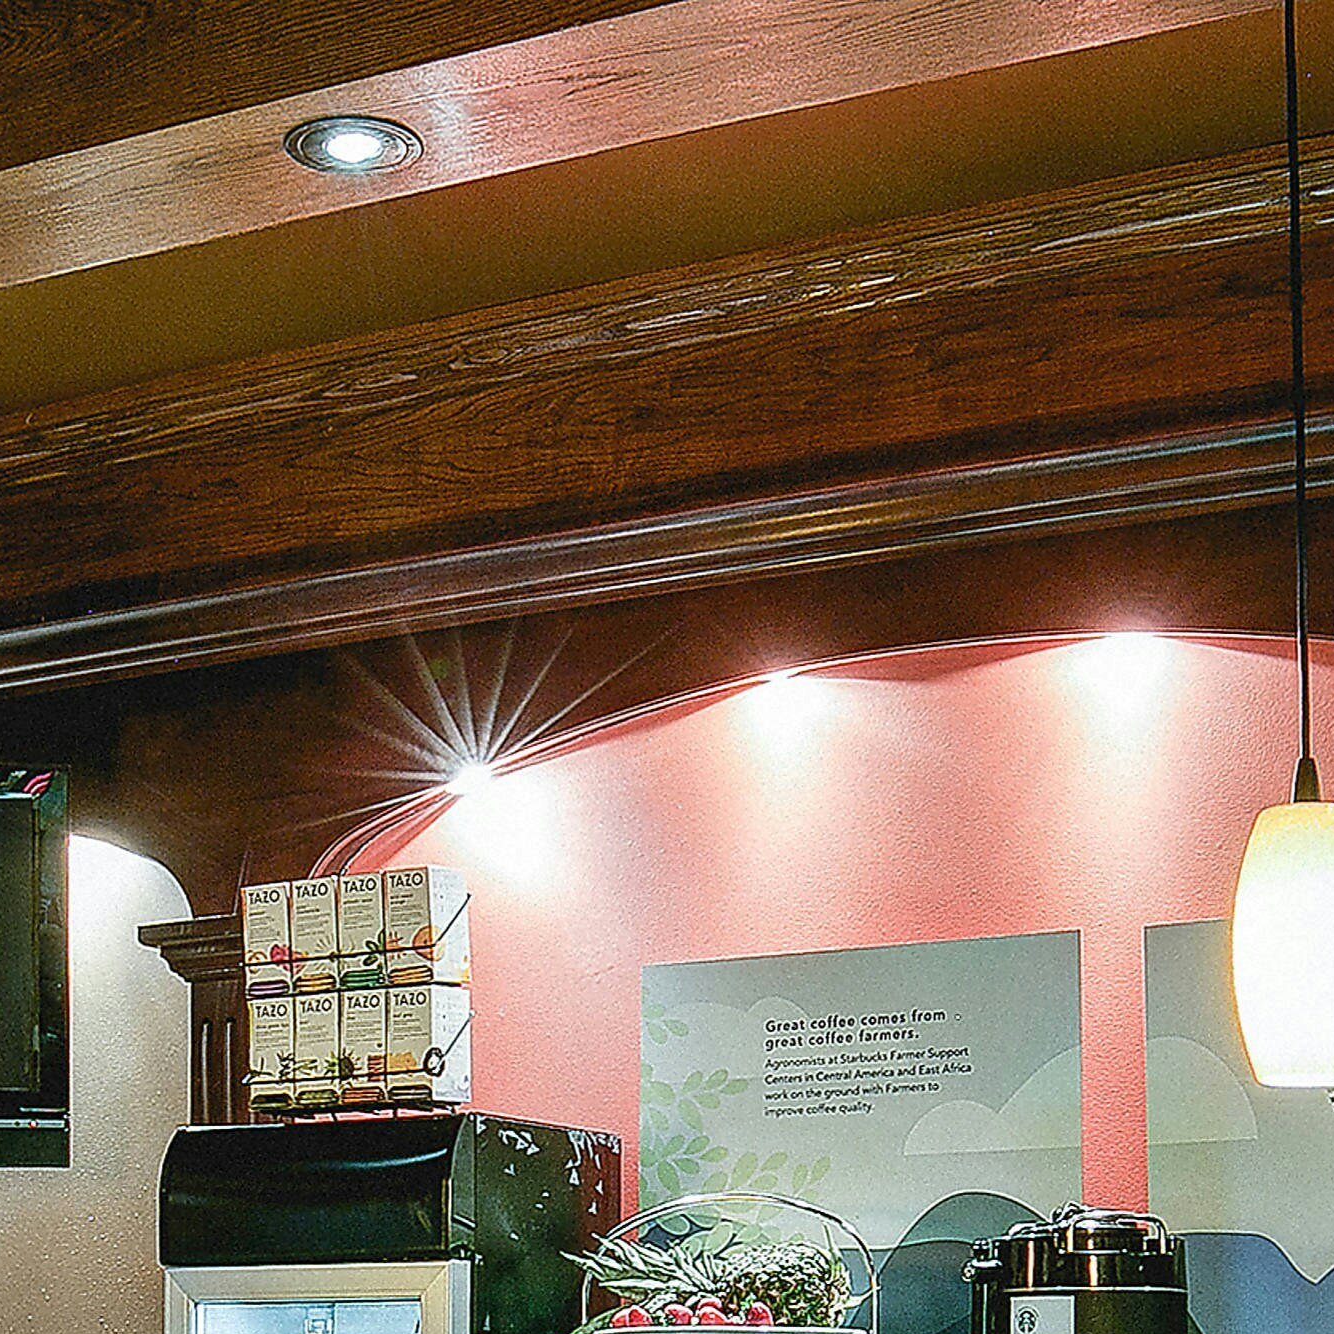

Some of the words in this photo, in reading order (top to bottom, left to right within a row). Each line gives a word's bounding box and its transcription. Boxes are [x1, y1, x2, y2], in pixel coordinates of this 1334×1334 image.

[342, 877, 377, 893] TAZO
[389, 872, 424, 888] TAZO
[248, 889, 280, 905] TAZO
[294, 882, 329, 898] TAZO
[299, 998, 333, 1014] TAZO
[346, 994, 381, 1009] TAZO
[392, 991, 427, 1006] TAZO
[255, 1003, 288, 1018] TAZO
[765, 1019, 805, 1033] Great
[810, 1014, 856, 1030] coffee
[860, 1013, 906, 1026] comes
[911, 1008, 946, 1022] from
[765, 1036, 803, 1052] great
[808, 1031, 854, 1046] coffee
[858, 1029, 919, 1042] farmers.
[765, 1057, 826, 1071] Agronomists
[828, 1056, 838, 1065] at
[840, 1051, 888, 1065] Starbucks
[890, 1048, 926, 1061] Farmer
[927, 1047, 969, 1060] Support
[765, 1074, 803, 1085] Centers
[804, 1072, 815, 1082] in
[816, 1070, 852, 1082] Central
[854, 1067, 895, 1079] America
[897, 1064, 917, 1077] and
[919, 1064, 940, 1075] East
[942, 1062, 972, 1074] Africa
[765, 1089, 788, 1100] work
[790, 1091, 804, 1099] on
[806, 1088, 822, 1099] the
[824, 1085, 860, 1100] ground
[862, 1083, 883, 1095] with
[885, 1082, 926, 1094] Farmers
[928, 1082, 940, 1091] to
[764, 1106, 804, 1118] improve
[806, 1103, 836, 1115] coffee
